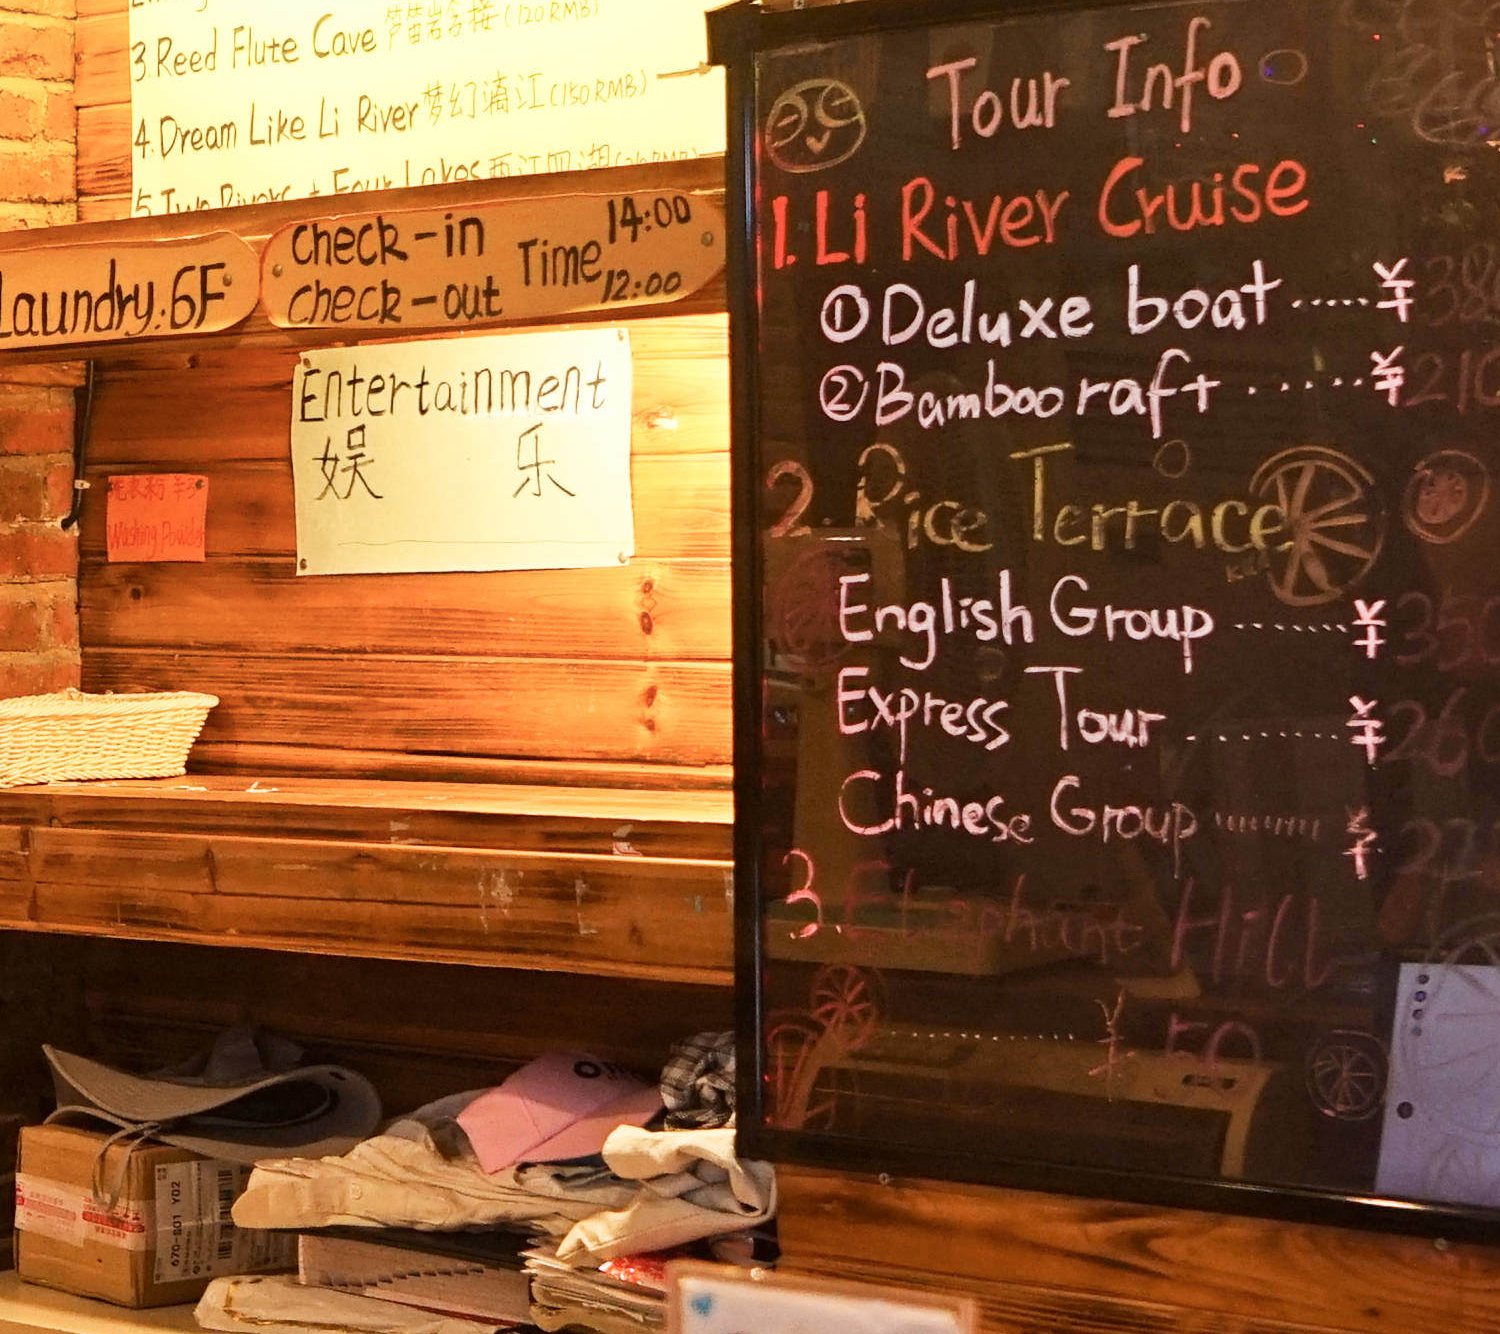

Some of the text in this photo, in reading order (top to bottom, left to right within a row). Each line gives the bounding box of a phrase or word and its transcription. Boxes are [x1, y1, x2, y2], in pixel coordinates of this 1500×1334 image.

[231, 13, 377, 69] Flute Cave
[929, 17, 1241, 150] Tour Info
[249, 92, 419, 145] Like Li River
[606, 196, 692, 243] 14:00
[903, 176, 1070, 261] River
[1099, 158, 1310, 238] Cruise
[518, 239, 602, 289] Time
[600, 271, 681, 305] 12:00
[1128, 261, 1281, 330] boat
[300, 361, 606, 424] Entertainment
[1077, 350, 1219, 439] raft
[857, 443, 1297, 552] Rice Terrace
[838, 570, 1214, 672] English Group
[838, 667, 1166, 763] Express Tour
[840, 771, 1197, 879] Chinese Group
[1171, 879, 1336, 987] Hill
